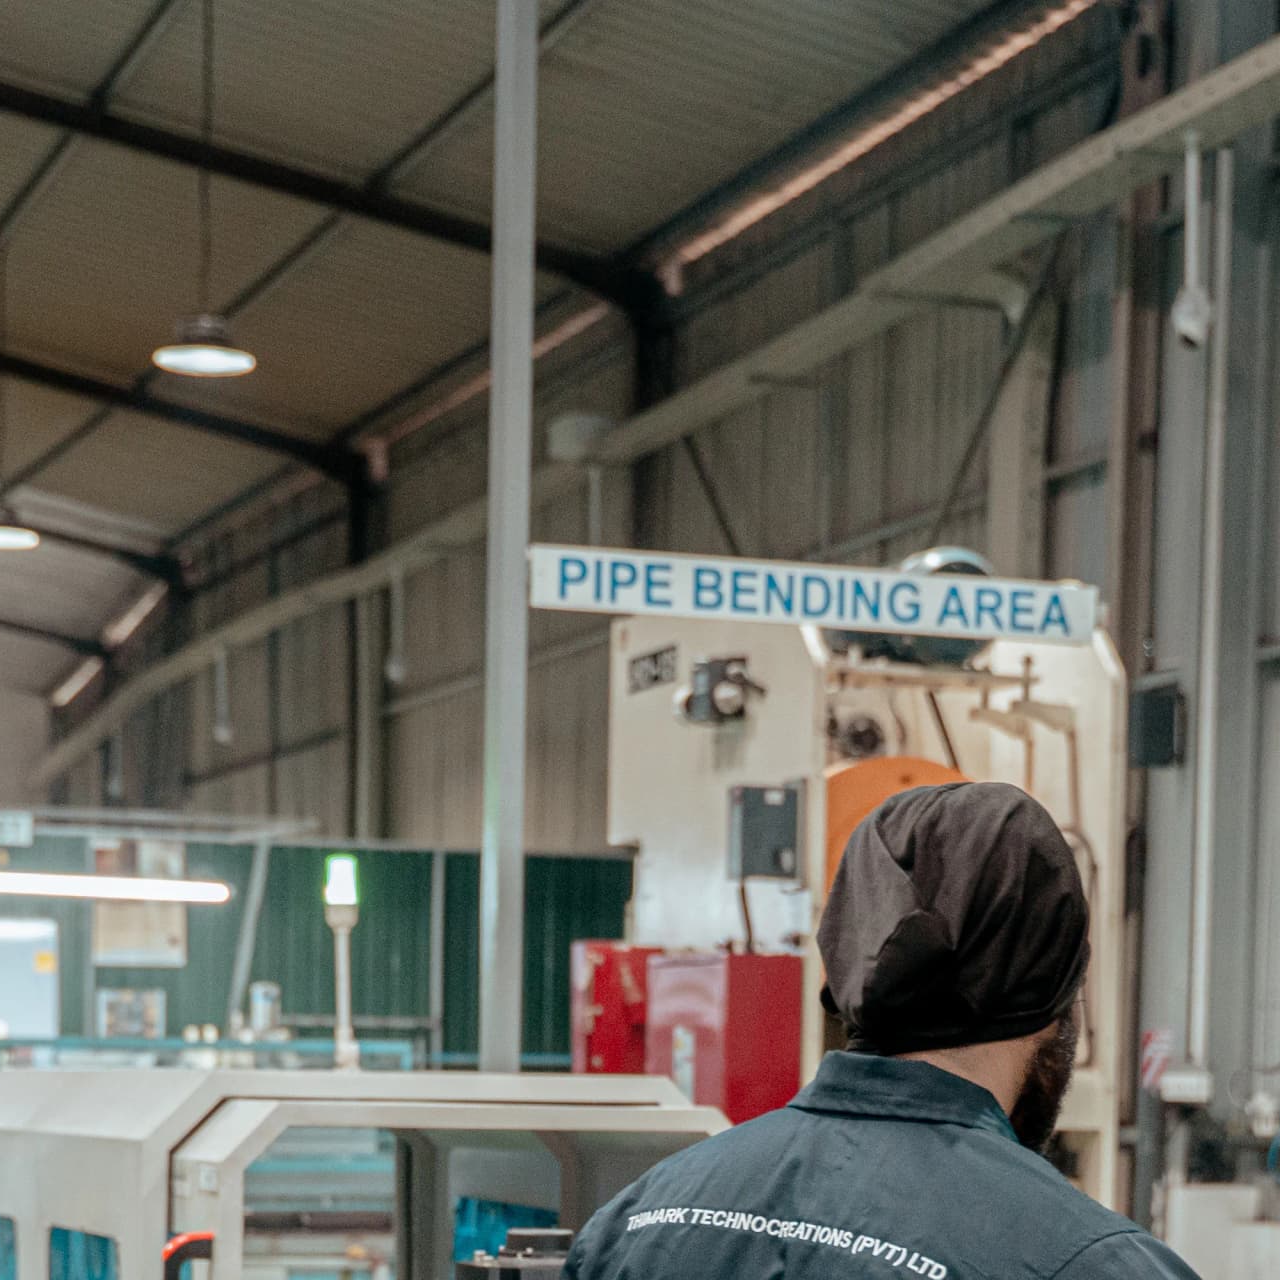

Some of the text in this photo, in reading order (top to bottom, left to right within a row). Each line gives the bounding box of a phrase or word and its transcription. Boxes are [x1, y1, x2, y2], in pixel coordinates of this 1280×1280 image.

[558, 556, 1072, 636] PIPE BENDING AREA
[690, 1208, 854, 1249] TECHNOCREATIONS
[851, 1234, 908, 1267] (PVT)
[906, 1252, 948, 1280] LTD
